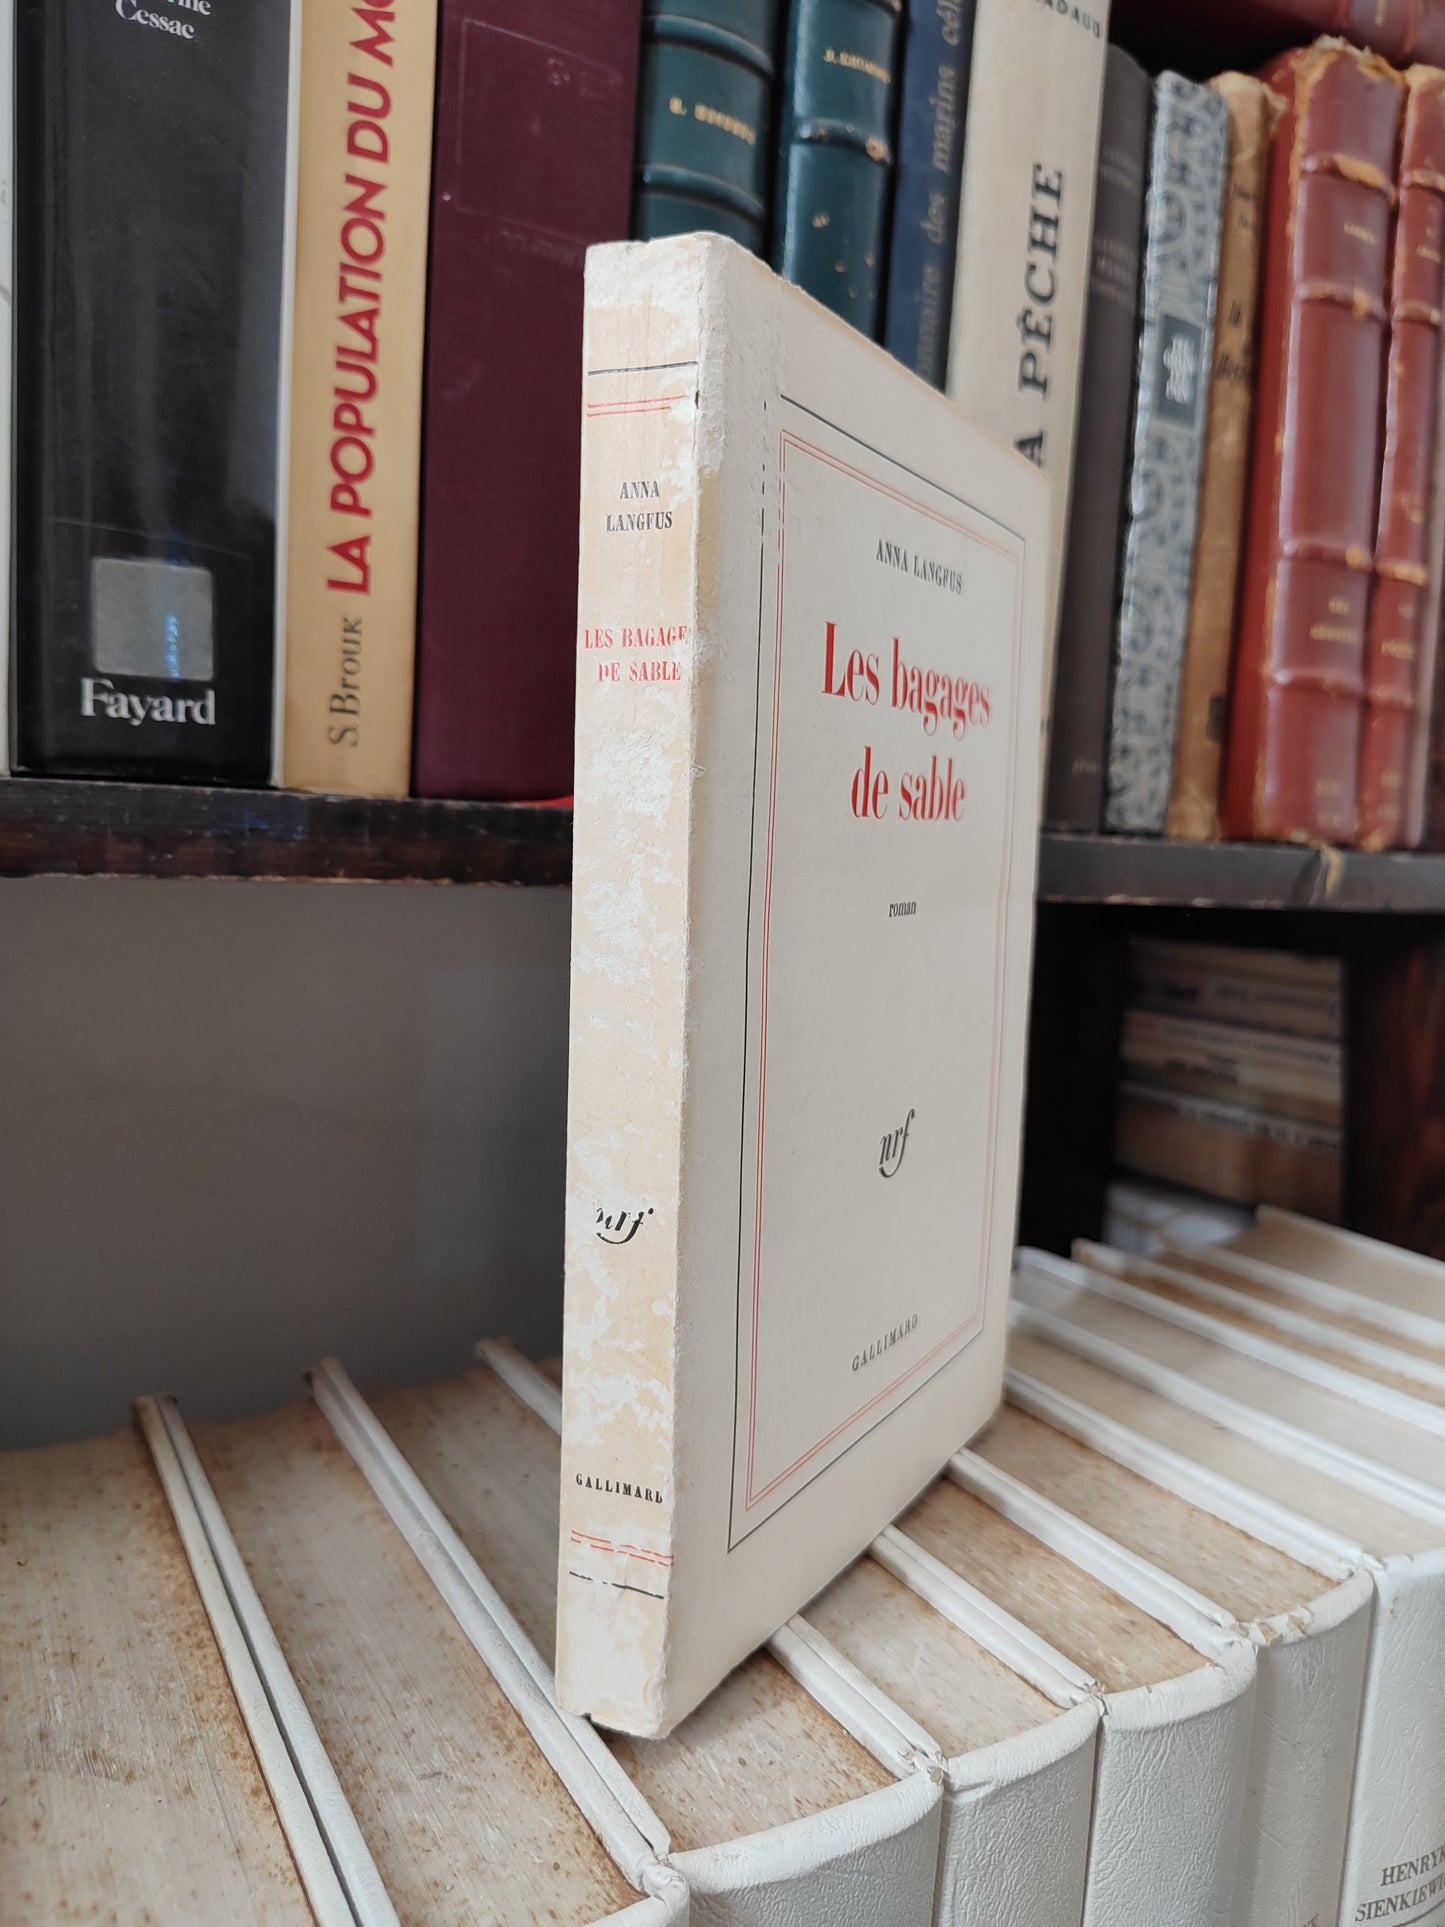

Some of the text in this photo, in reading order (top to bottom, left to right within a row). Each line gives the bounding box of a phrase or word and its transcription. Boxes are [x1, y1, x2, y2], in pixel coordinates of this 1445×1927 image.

[115, 0, 195, 39] Cessac
[327, 0, 396, 596] LA POPULATION DU M
[1016, 162, 1063, 400] PÊCHE
[619, 480, 660, 500] ANNA
[606, 511, 673, 533] LANGFUS
[876, 538, 963, 595] ANNA LANGFUS
[584, 625, 692, 649] LES BAGAGE
[629, 661, 682, 681] SABLE
[821, 621, 991, 742] Les bagages
[81, 677, 216, 726] Fayard
[851, 745, 967, 823] de sable
[889, 900, 917, 918] roman
[879, 1107, 915, 1178] nrf
[852, 1314, 918, 1372] GALLIMARD
[575, 1472, 663, 1504] GALLIMARD
[1355, 1872, 1445, 1922] SIENKIEWI
